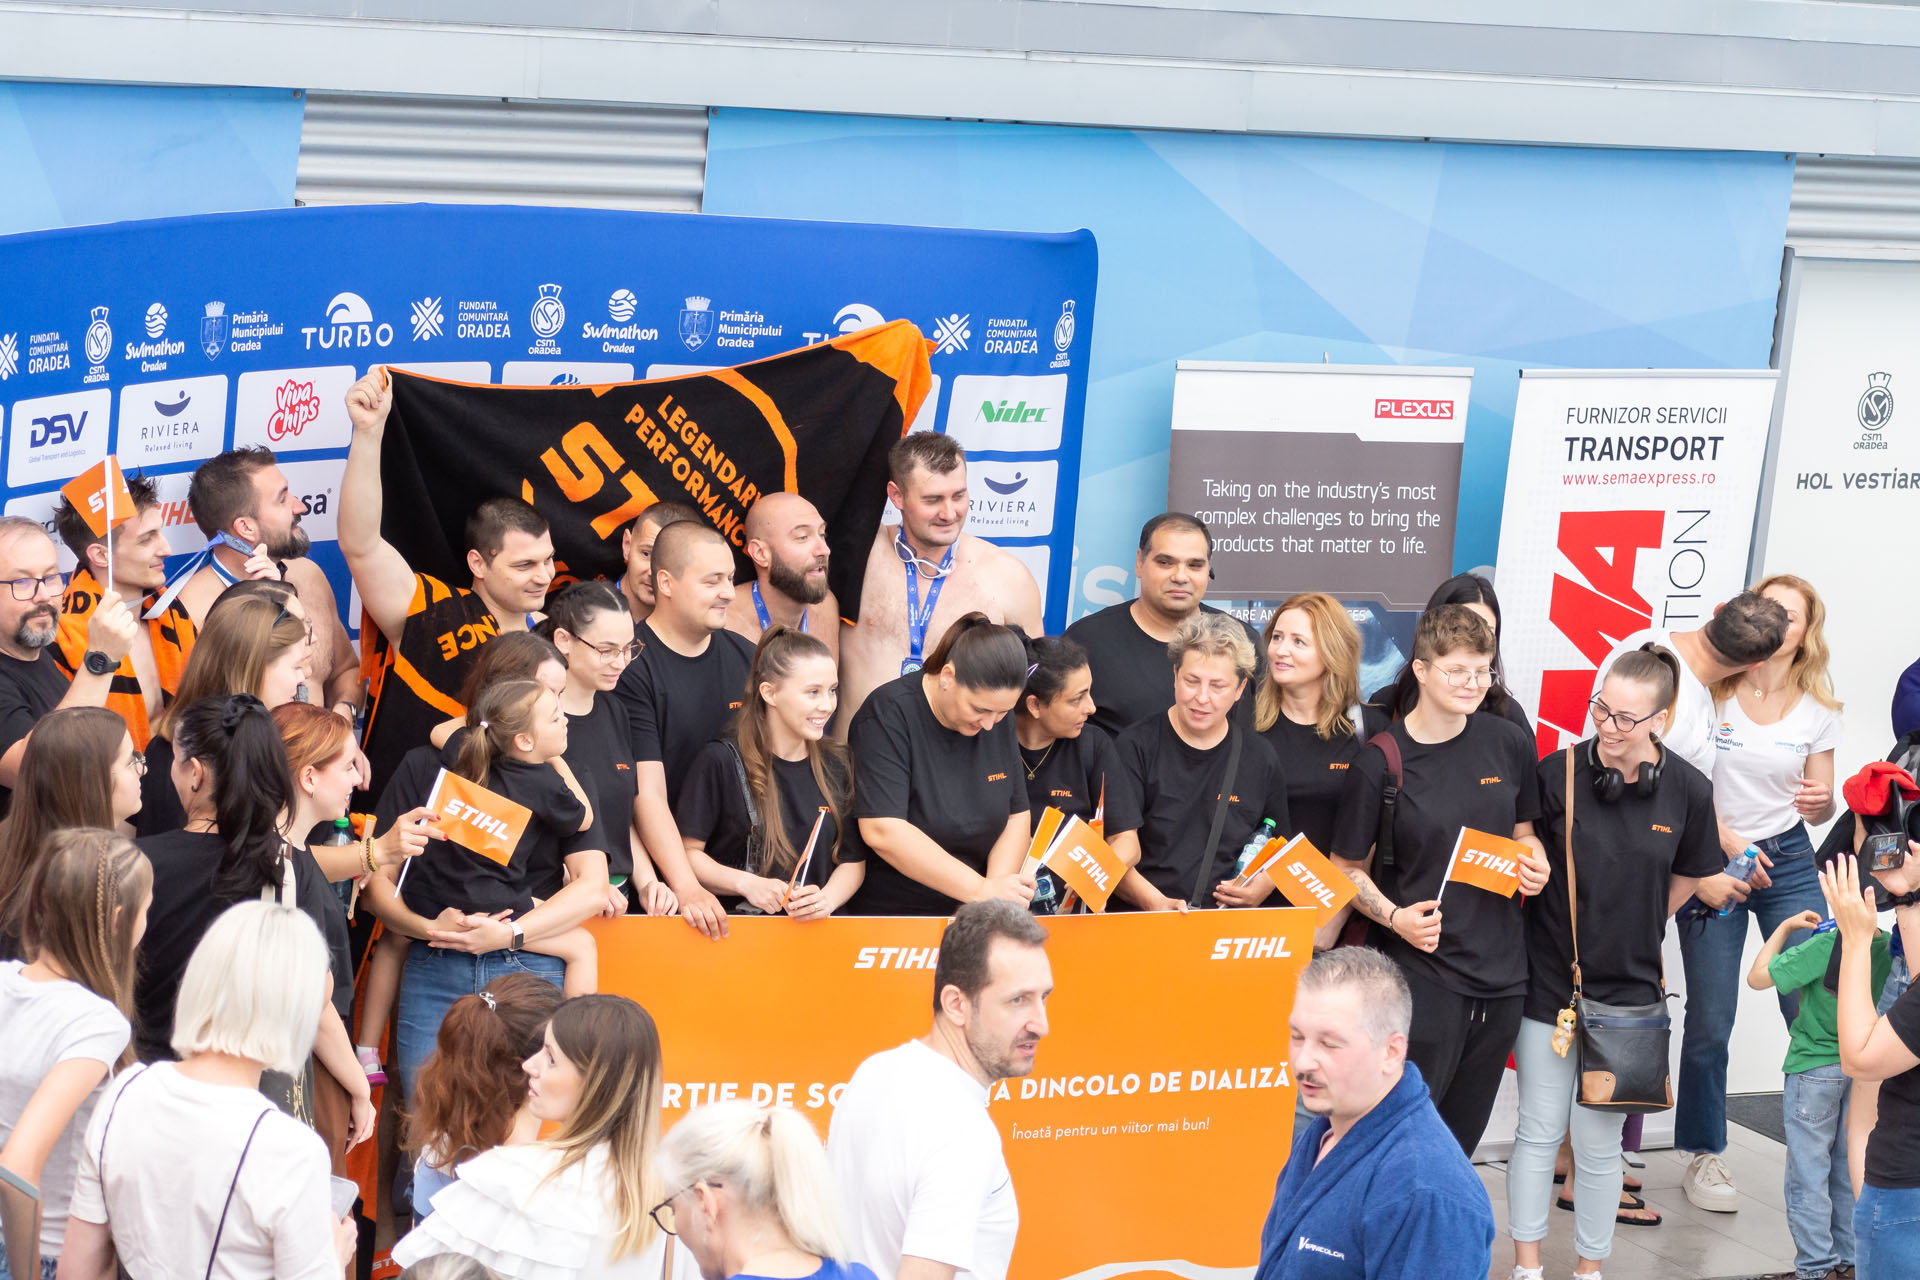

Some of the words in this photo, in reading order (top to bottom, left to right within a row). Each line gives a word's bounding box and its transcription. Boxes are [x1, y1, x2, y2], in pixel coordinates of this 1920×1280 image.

[233, 310, 268, 324] Primăria
[720, 310, 764, 323] Primăria
[231, 323, 284, 339] Municipiului
[301, 322, 393, 350] TURBO
[457, 323, 511, 338] ORADEA
[582, 321, 658, 342] Swimathon
[718, 324, 782, 337] Municipiului
[125, 338, 185, 360] Swimathon
[231, 341, 261, 353] Oradea
[602, 341, 635, 354] Oradea
[717, 337, 754, 348] Oradea
[984, 340, 1038, 354] ORADEA
[28, 354, 71, 374] ORADEA
[141, 360, 167, 373] Oradea
[276, 379, 313, 411] Viva
[974, 400, 1052, 424] Nidec
[1376, 400, 1453, 418] PLEXUS
[1566, 406, 1651, 424] FURNIZOR
[1656, 406, 1728, 424] SERVICII
[267, 396, 320, 442] Chips
[30, 410, 88, 448] DSV
[141, 421, 200, 440] RIVIERA
[1861, 433, 1883, 441] csm
[1564, 436, 1725, 461] TRANSPORT
[624, 403, 749, 555] PERFORMANC
[1562, 472, 1716, 487] www.semaexpress.ro
[1796, 472, 1833, 490] HOL
[1203, 479, 1251, 502] Taking
[1258, 484, 1277, 498] on
[1284, 481, 1310, 498] the
[1317, 481, 1390, 504] industry's
[1397, 485, 1436, 500] most
[157, 500, 197, 528] IHL
[969, 500, 1036, 513] RIVIERA
[1263, 507, 1341, 531] challenges
[1349, 510, 1364, 526] to
[1371, 509, 1410, 531] bring
[1416, 510, 1441, 527] the
[1281, 535, 1314, 553] that
[1321, 537, 1373, 553] matter
[1379, 537, 1396, 553] to
[1402, 536, 1427, 554] life.
[1662, 509, 1711, 629] TION
[1480, 776, 1502, 785] STIHL
[1050, 789, 1073, 797] STIHL
[444, 798, 508, 840] STIHL
[1651, 824, 1673, 833] STIHL
[1067, 845, 1110, 892] STIHL
[1461, 849, 1518, 877] STIHL
[1286, 861, 1335, 908] STIHL
[1210, 936, 1292, 960] STIHL
[751, 1082, 795, 1108] DE
[1020, 1073, 1141, 1100] DINCOLO
[1149, 1071, 1182, 1093] DE
[1190, 1061, 1290, 1091] DIALIZĂ
[1012, 1122, 1051, 1140] Înoată
[1055, 1124, 1098, 1141] pentru
[1102, 1126, 1117, 1136] un
[1121, 1121, 1153, 1134] viitor
[1157, 1119, 1179, 1132] mai
[1182, 1116, 1211, 1131] bun!
